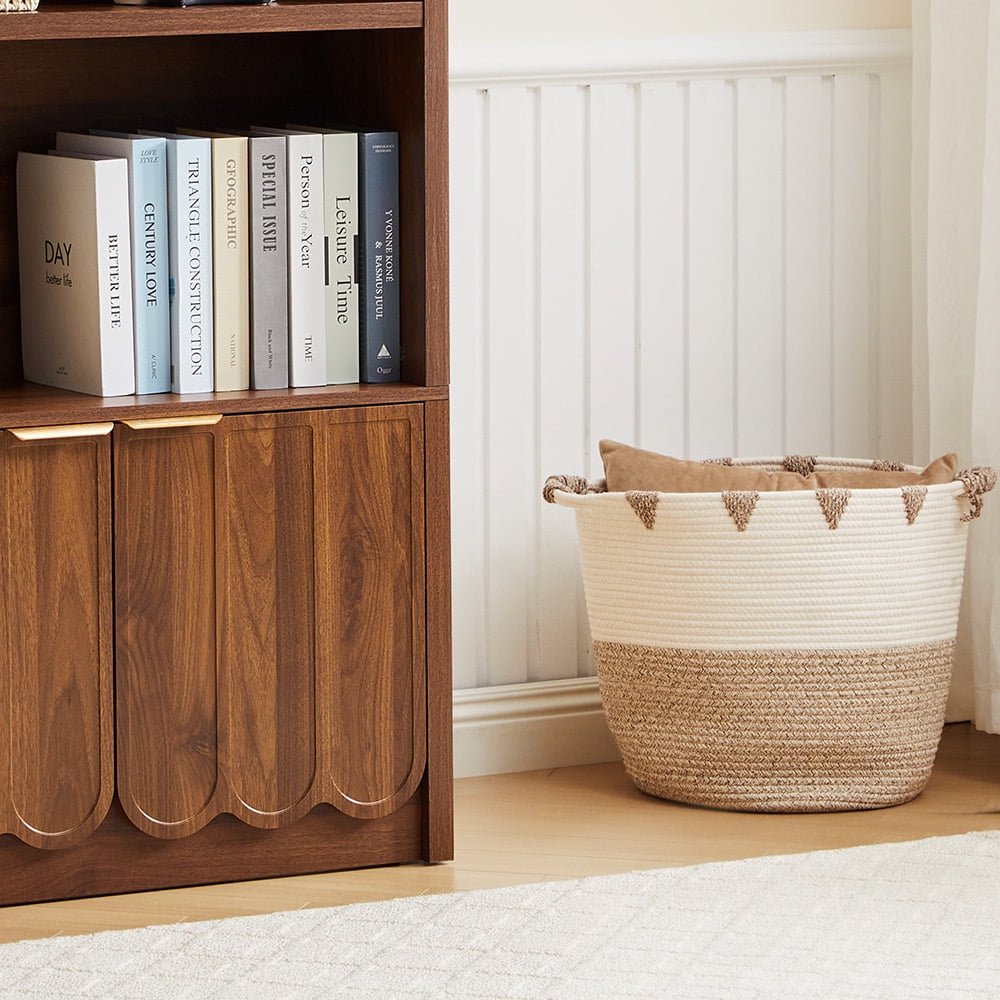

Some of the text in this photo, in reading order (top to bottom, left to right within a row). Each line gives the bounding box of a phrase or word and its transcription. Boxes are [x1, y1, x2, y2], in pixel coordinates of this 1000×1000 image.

[226, 159, 237, 249] GEOGRAPHIC
[262, 154, 277, 252] SPECIAL ISSUE
[301, 156, 313, 208] Person
[45, 240, 72, 267] DAY
[144, 202, 158, 307] CENTURY LOVE
[188, 158, 203, 376] TRIANGLE CONSTRUCTION
[301, 234, 312, 268] Year
[336, 196, 352, 324] Leisure Time
[385, 209, 393, 253] YVONNE
[108, 235, 121, 329] BETTER LIFE
[375, 241, 384, 320] & RASMUS JUUL
[304, 337, 313, 362] TIME
